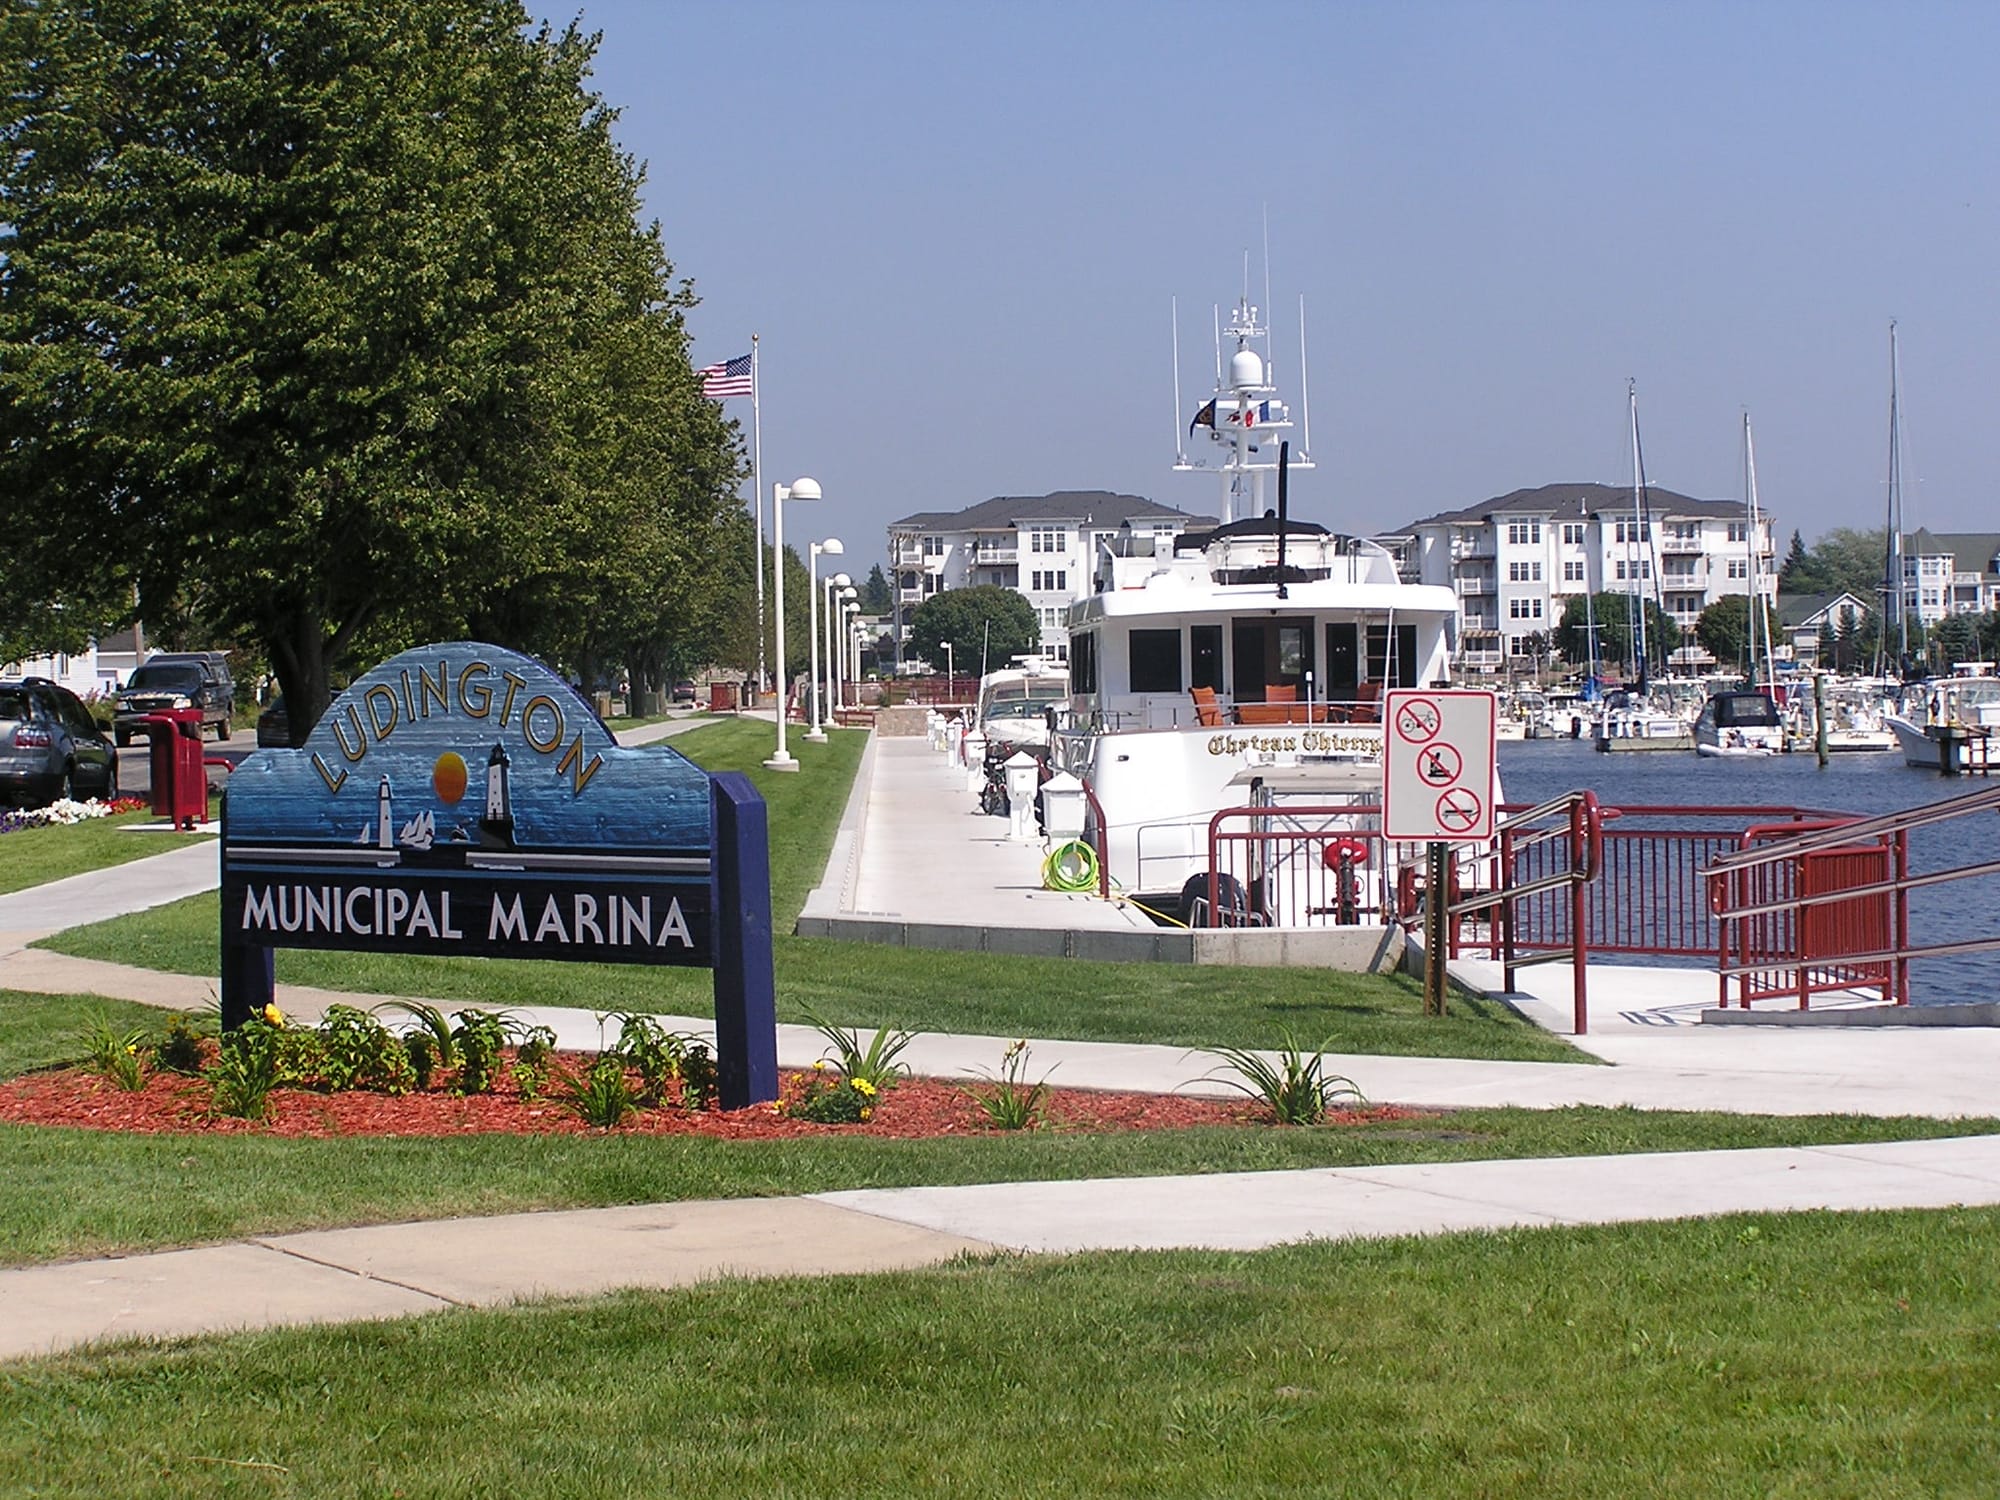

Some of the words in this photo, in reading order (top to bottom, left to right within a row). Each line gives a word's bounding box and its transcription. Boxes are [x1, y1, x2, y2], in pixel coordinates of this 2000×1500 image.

[311, 660, 605, 796] LUDINGTON
[242, 884, 463, 940] MUNICIPAL
[488, 891, 695, 948] MARINA
